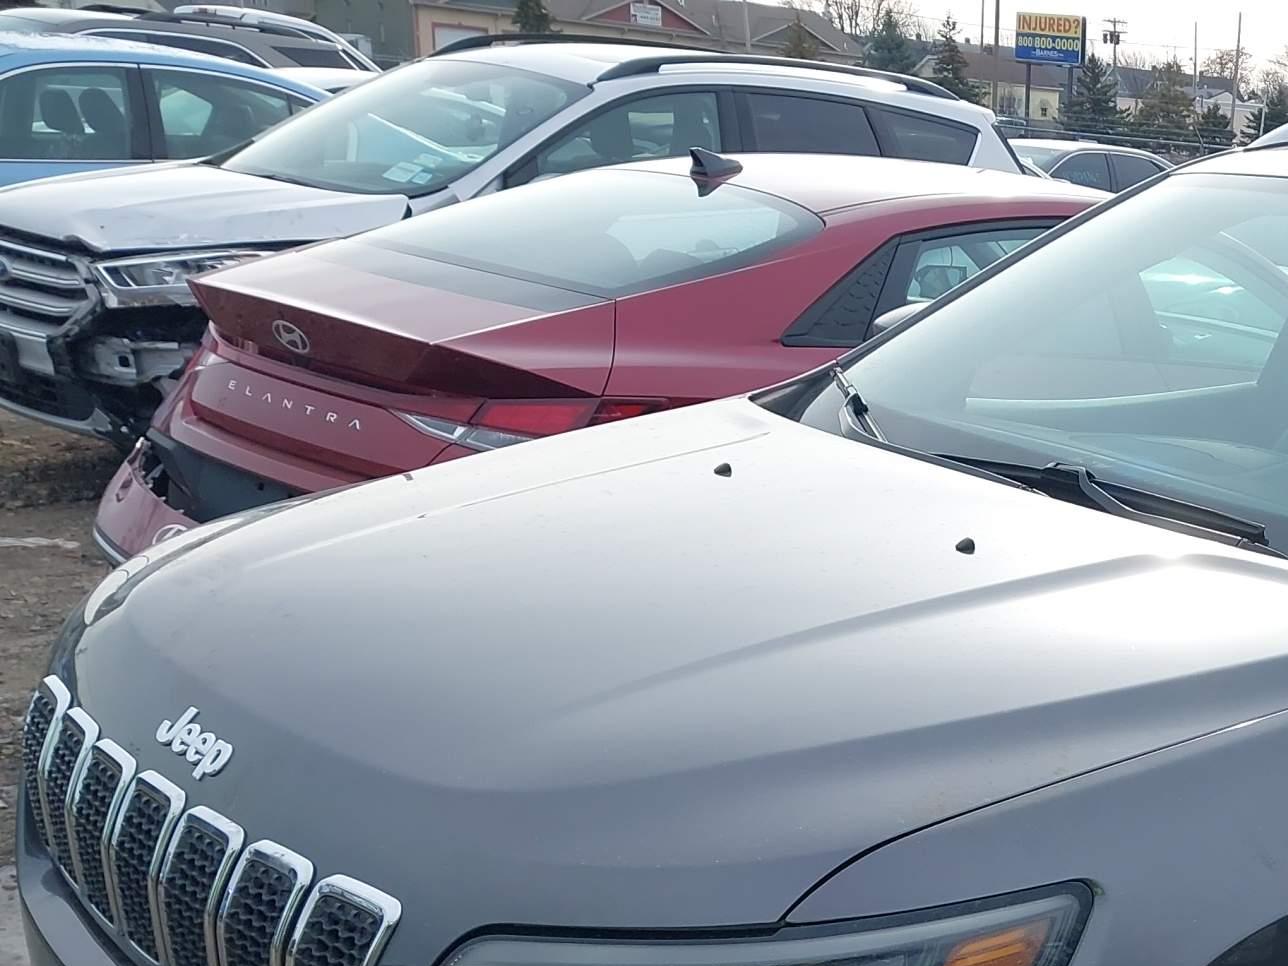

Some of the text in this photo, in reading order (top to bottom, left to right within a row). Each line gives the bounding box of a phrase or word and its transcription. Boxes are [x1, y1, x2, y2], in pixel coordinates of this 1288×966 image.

[1017, 14, 1080, 35] INJURED?
[1017, 36, 1080, 51] 800 800-0000
[227, 379, 361, 430] ELANTRA
[155, 705, 234, 781] Jeep
